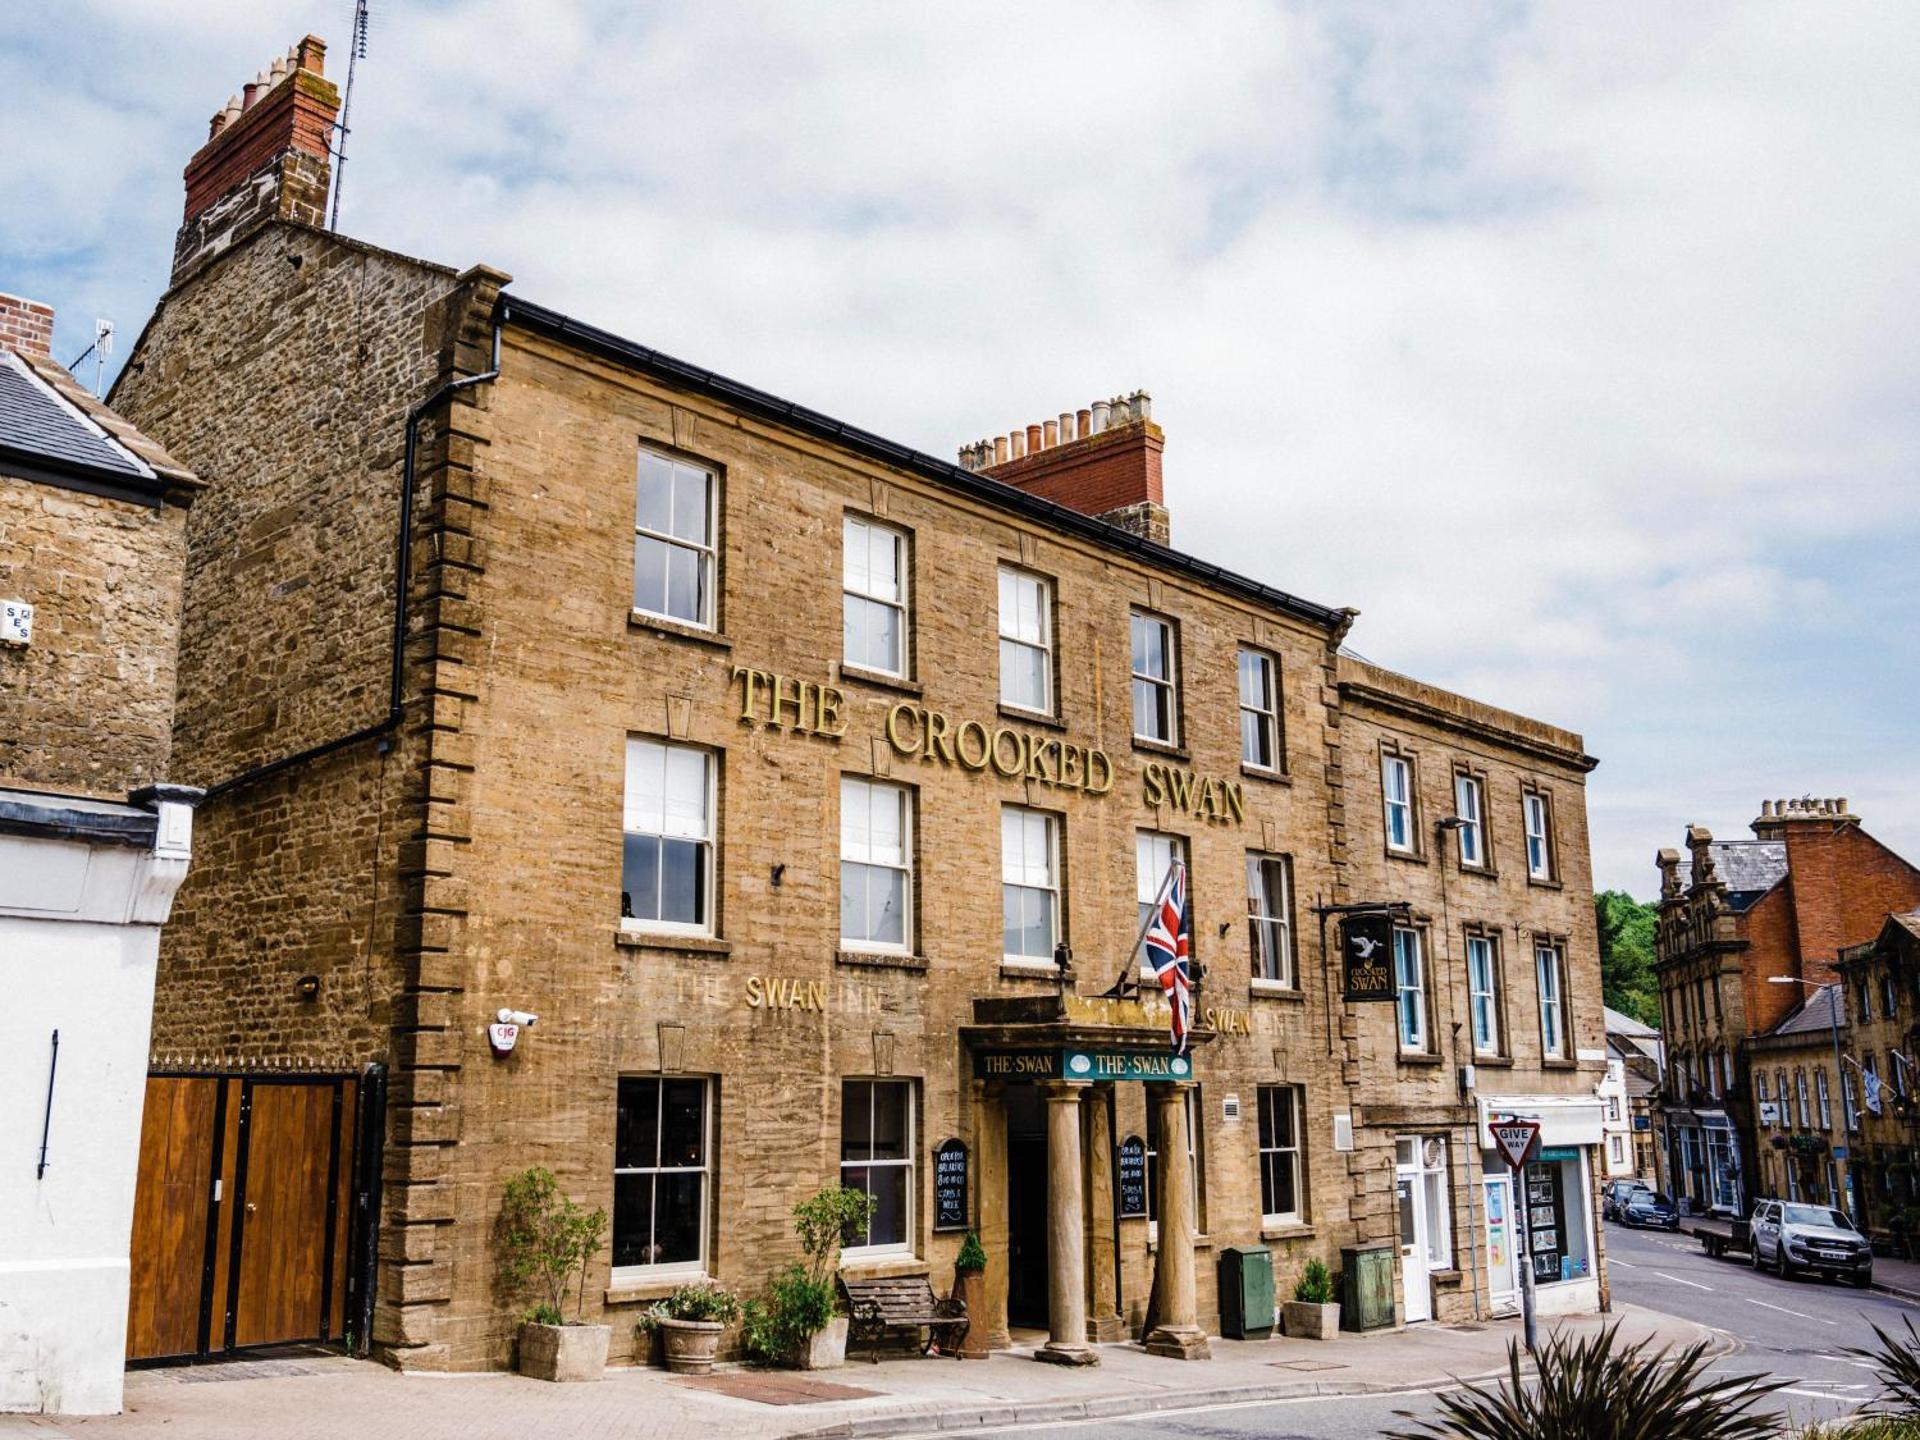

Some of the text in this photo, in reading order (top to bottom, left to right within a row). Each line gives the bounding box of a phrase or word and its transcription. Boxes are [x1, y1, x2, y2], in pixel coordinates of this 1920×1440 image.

[732, 664, 1245, 822] THE CROOKED SWAN
[1351, 975, 1388, 991] SWAN
[746, 976, 828, 1012] SWAN
[1206, 1007, 1250, 1036] SWAN
[497, 1027, 514, 1039] CJG
[984, 1055, 1053, 1073] THE SWAN
[1096, 1055, 1170, 1075] THE SWAN
[1500, 1128, 1529, 1139] GIVE
[1507, 1141, 1525, 1149] WAY
